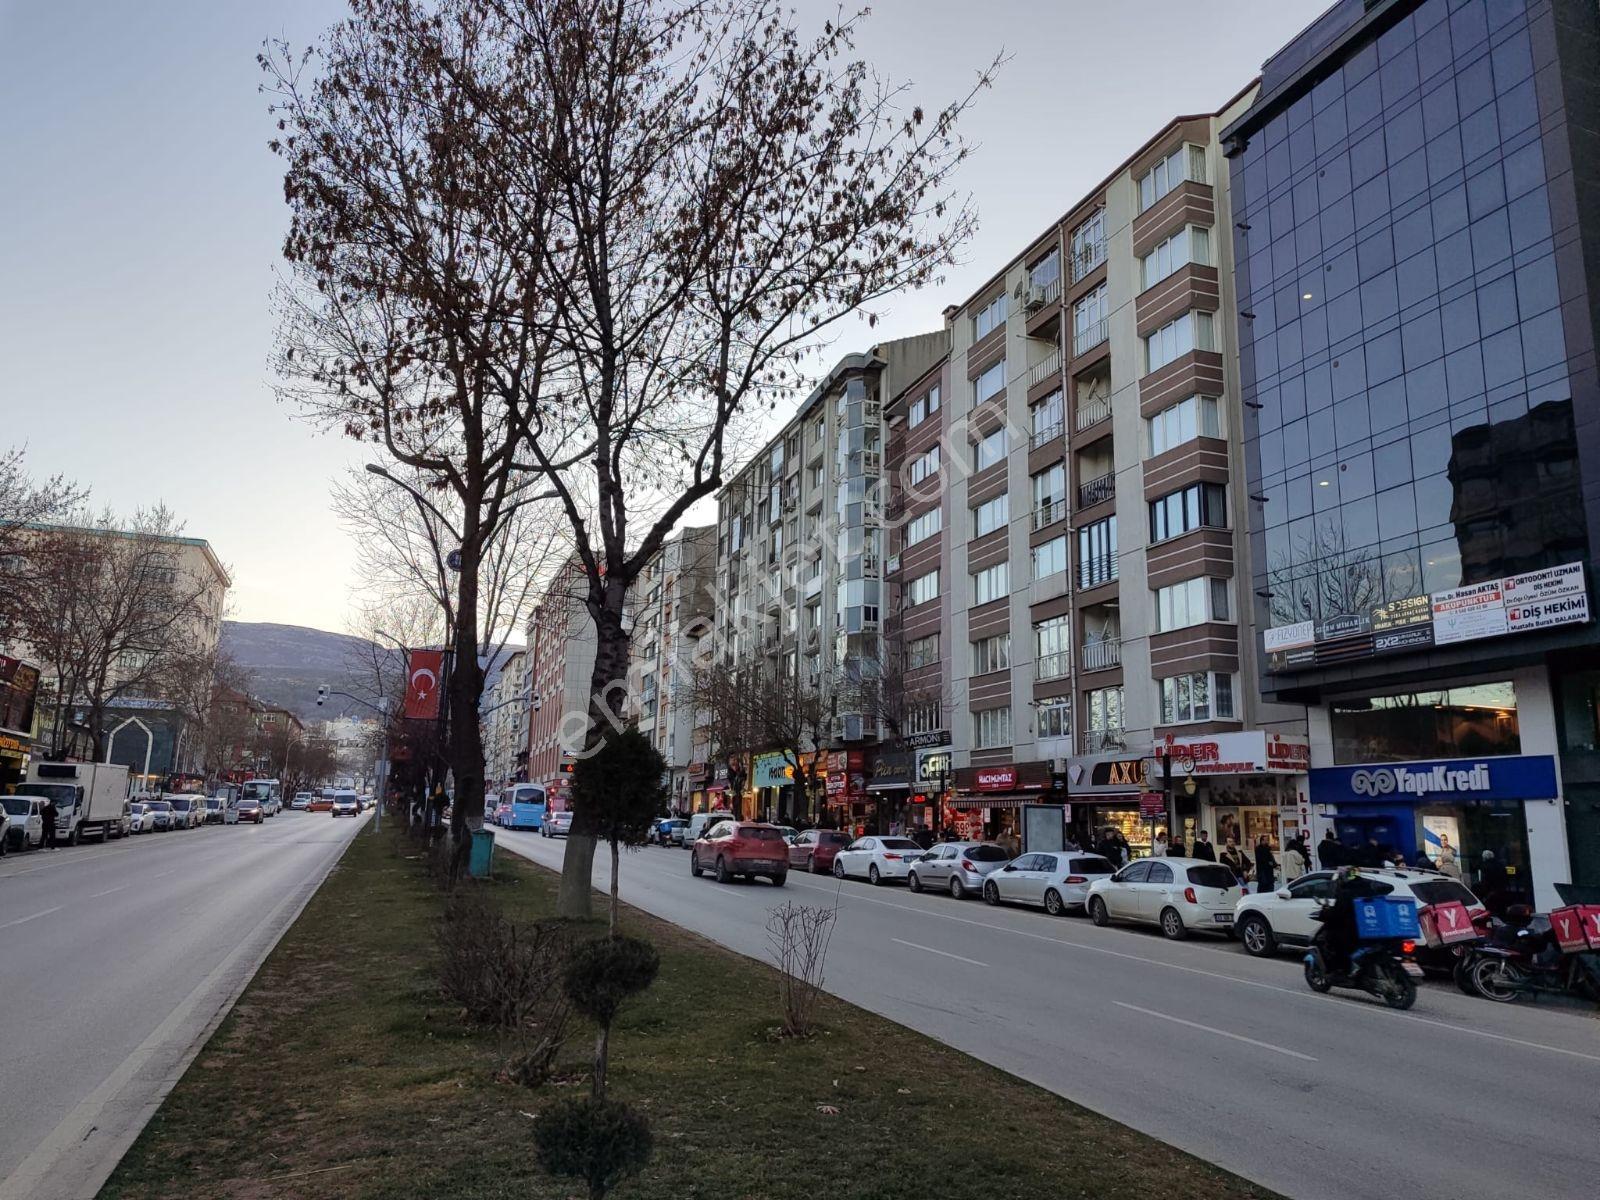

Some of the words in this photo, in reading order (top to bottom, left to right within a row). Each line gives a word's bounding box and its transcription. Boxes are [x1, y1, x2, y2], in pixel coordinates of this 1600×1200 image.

[1516, 571, 1553, 586] ORTODONTİ
[1553, 565, 1581, 577] UZMANI
[1455, 589, 1476, 598] Hasan
[1477, 583, 1499, 593] AKTAŞ
[1522, 605, 1541, 619] DİŞ
[1544, 595, 1585, 615] HEKİMİ
[1510, 622, 1535, 631] Mustafa
[1535, 618, 1554, 627] Burak
[1443, 907, 1457, 928] Y
